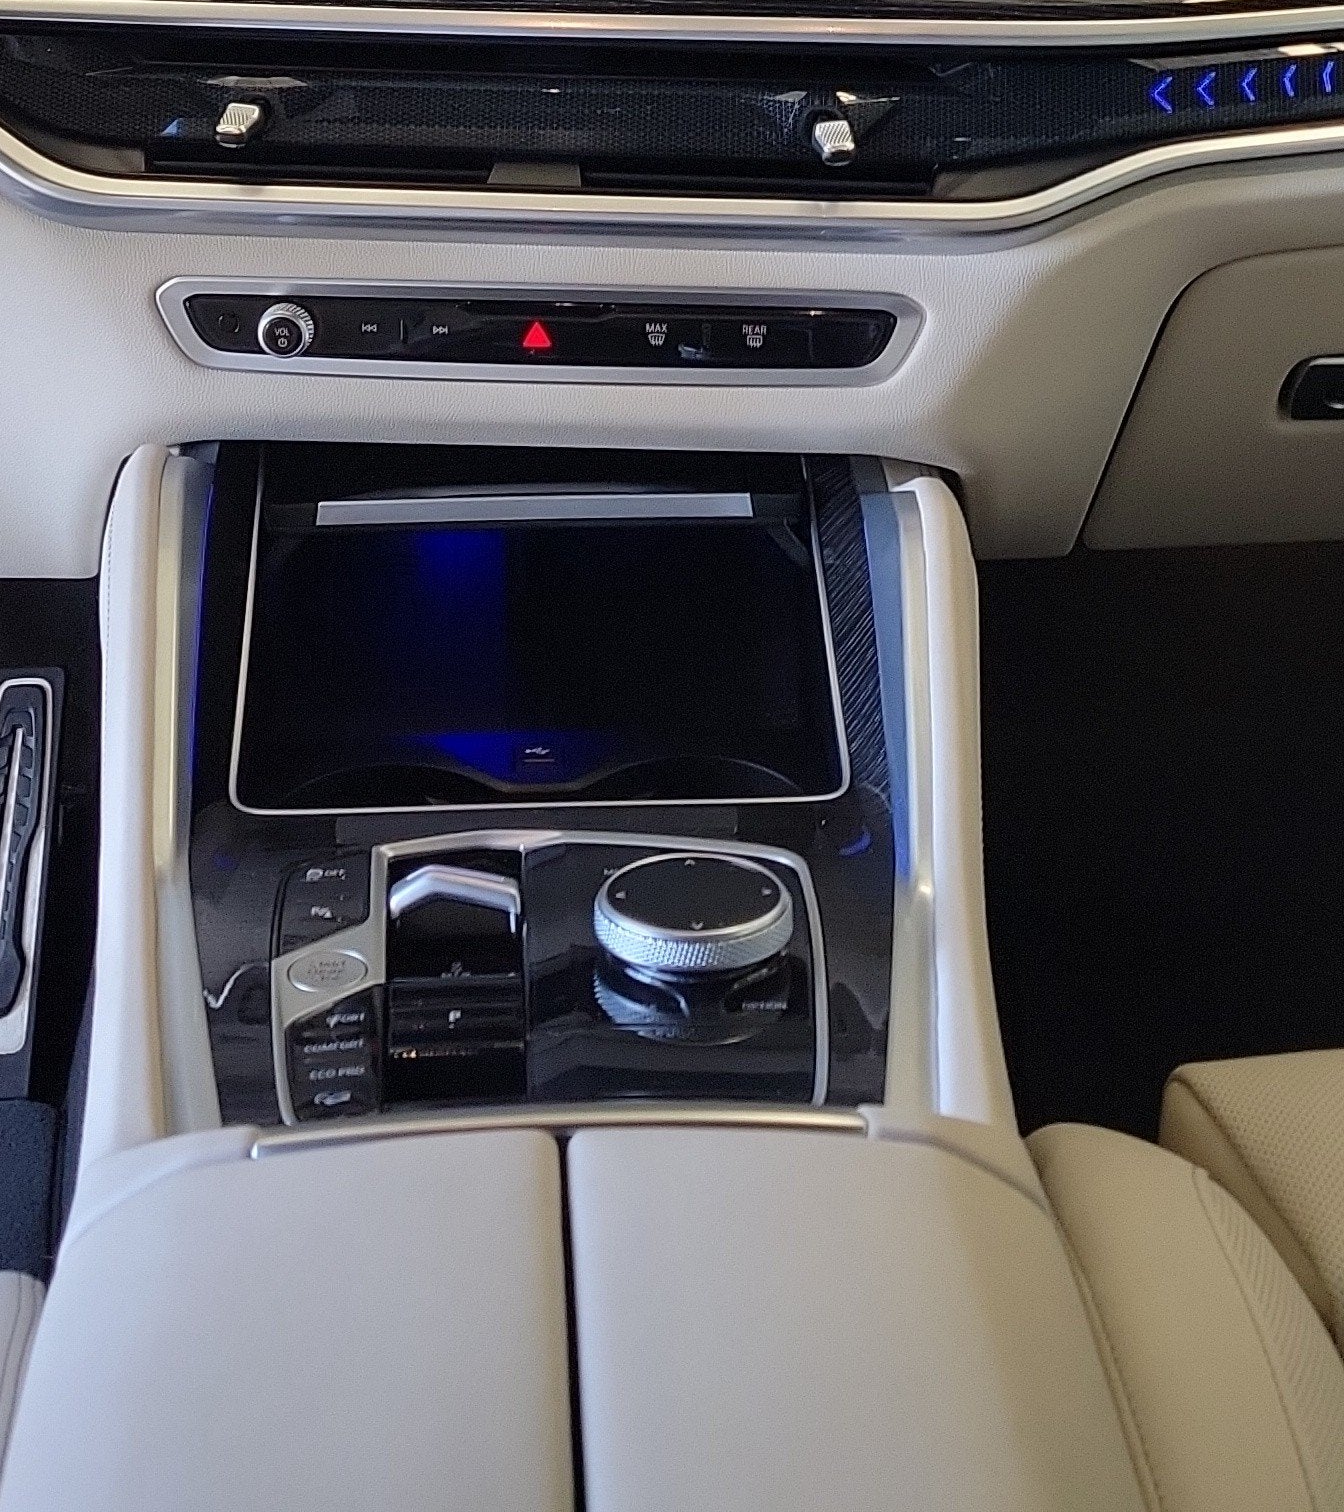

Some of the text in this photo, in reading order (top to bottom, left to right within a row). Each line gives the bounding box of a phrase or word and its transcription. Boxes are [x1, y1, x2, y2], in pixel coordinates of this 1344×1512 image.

[274, 327, 290, 336] VOL
[645, 322, 668, 333] MAX
[742, 324, 767, 336] REAR
